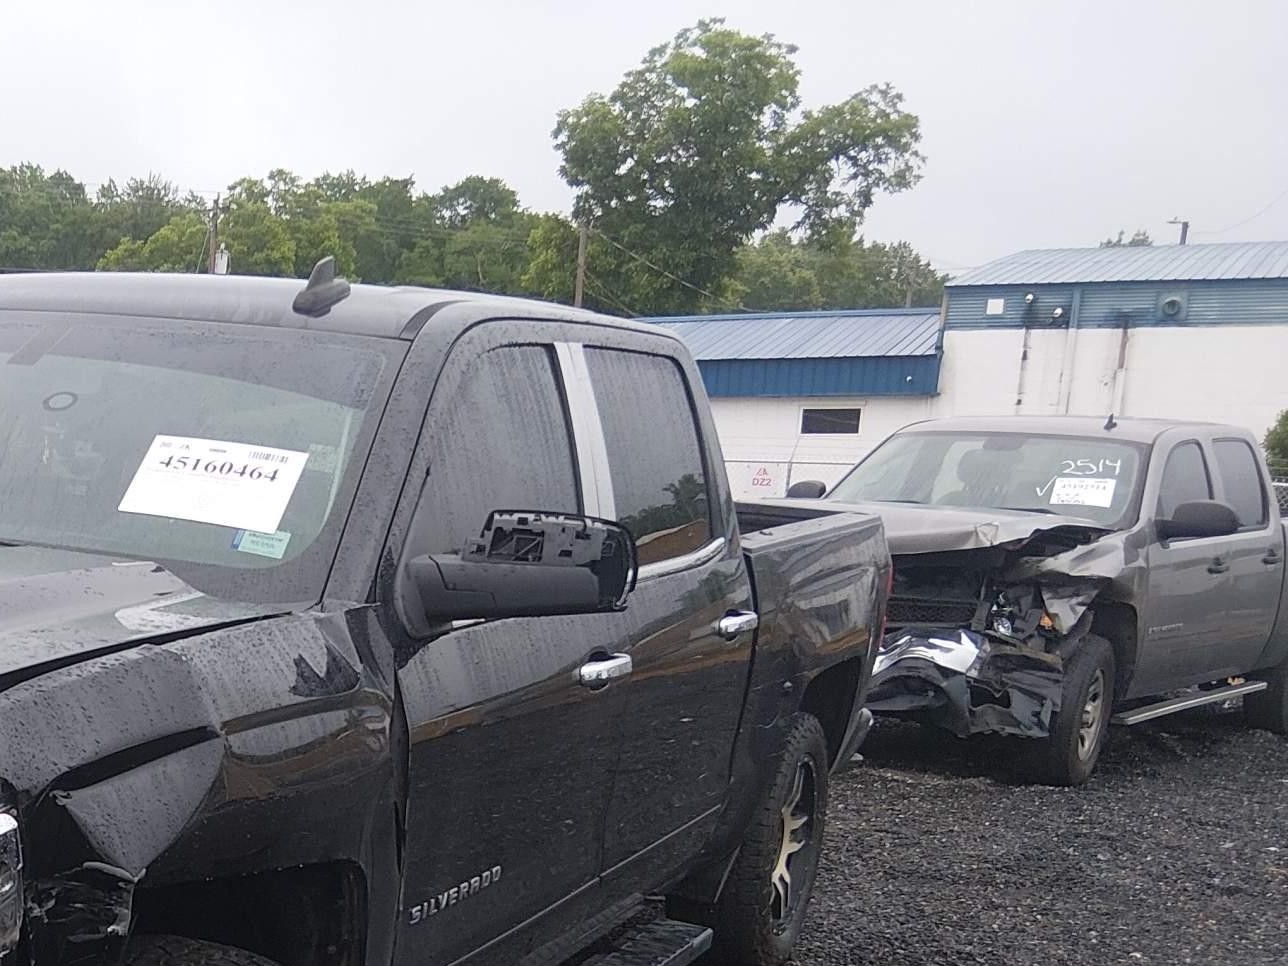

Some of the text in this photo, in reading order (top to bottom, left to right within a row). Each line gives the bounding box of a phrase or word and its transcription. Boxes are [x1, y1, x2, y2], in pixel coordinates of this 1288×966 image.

[159, 455, 280, 482] 45160464
[1061, 458, 1122, 475] 2514
[408, 865, 502, 925] SILVERADO
